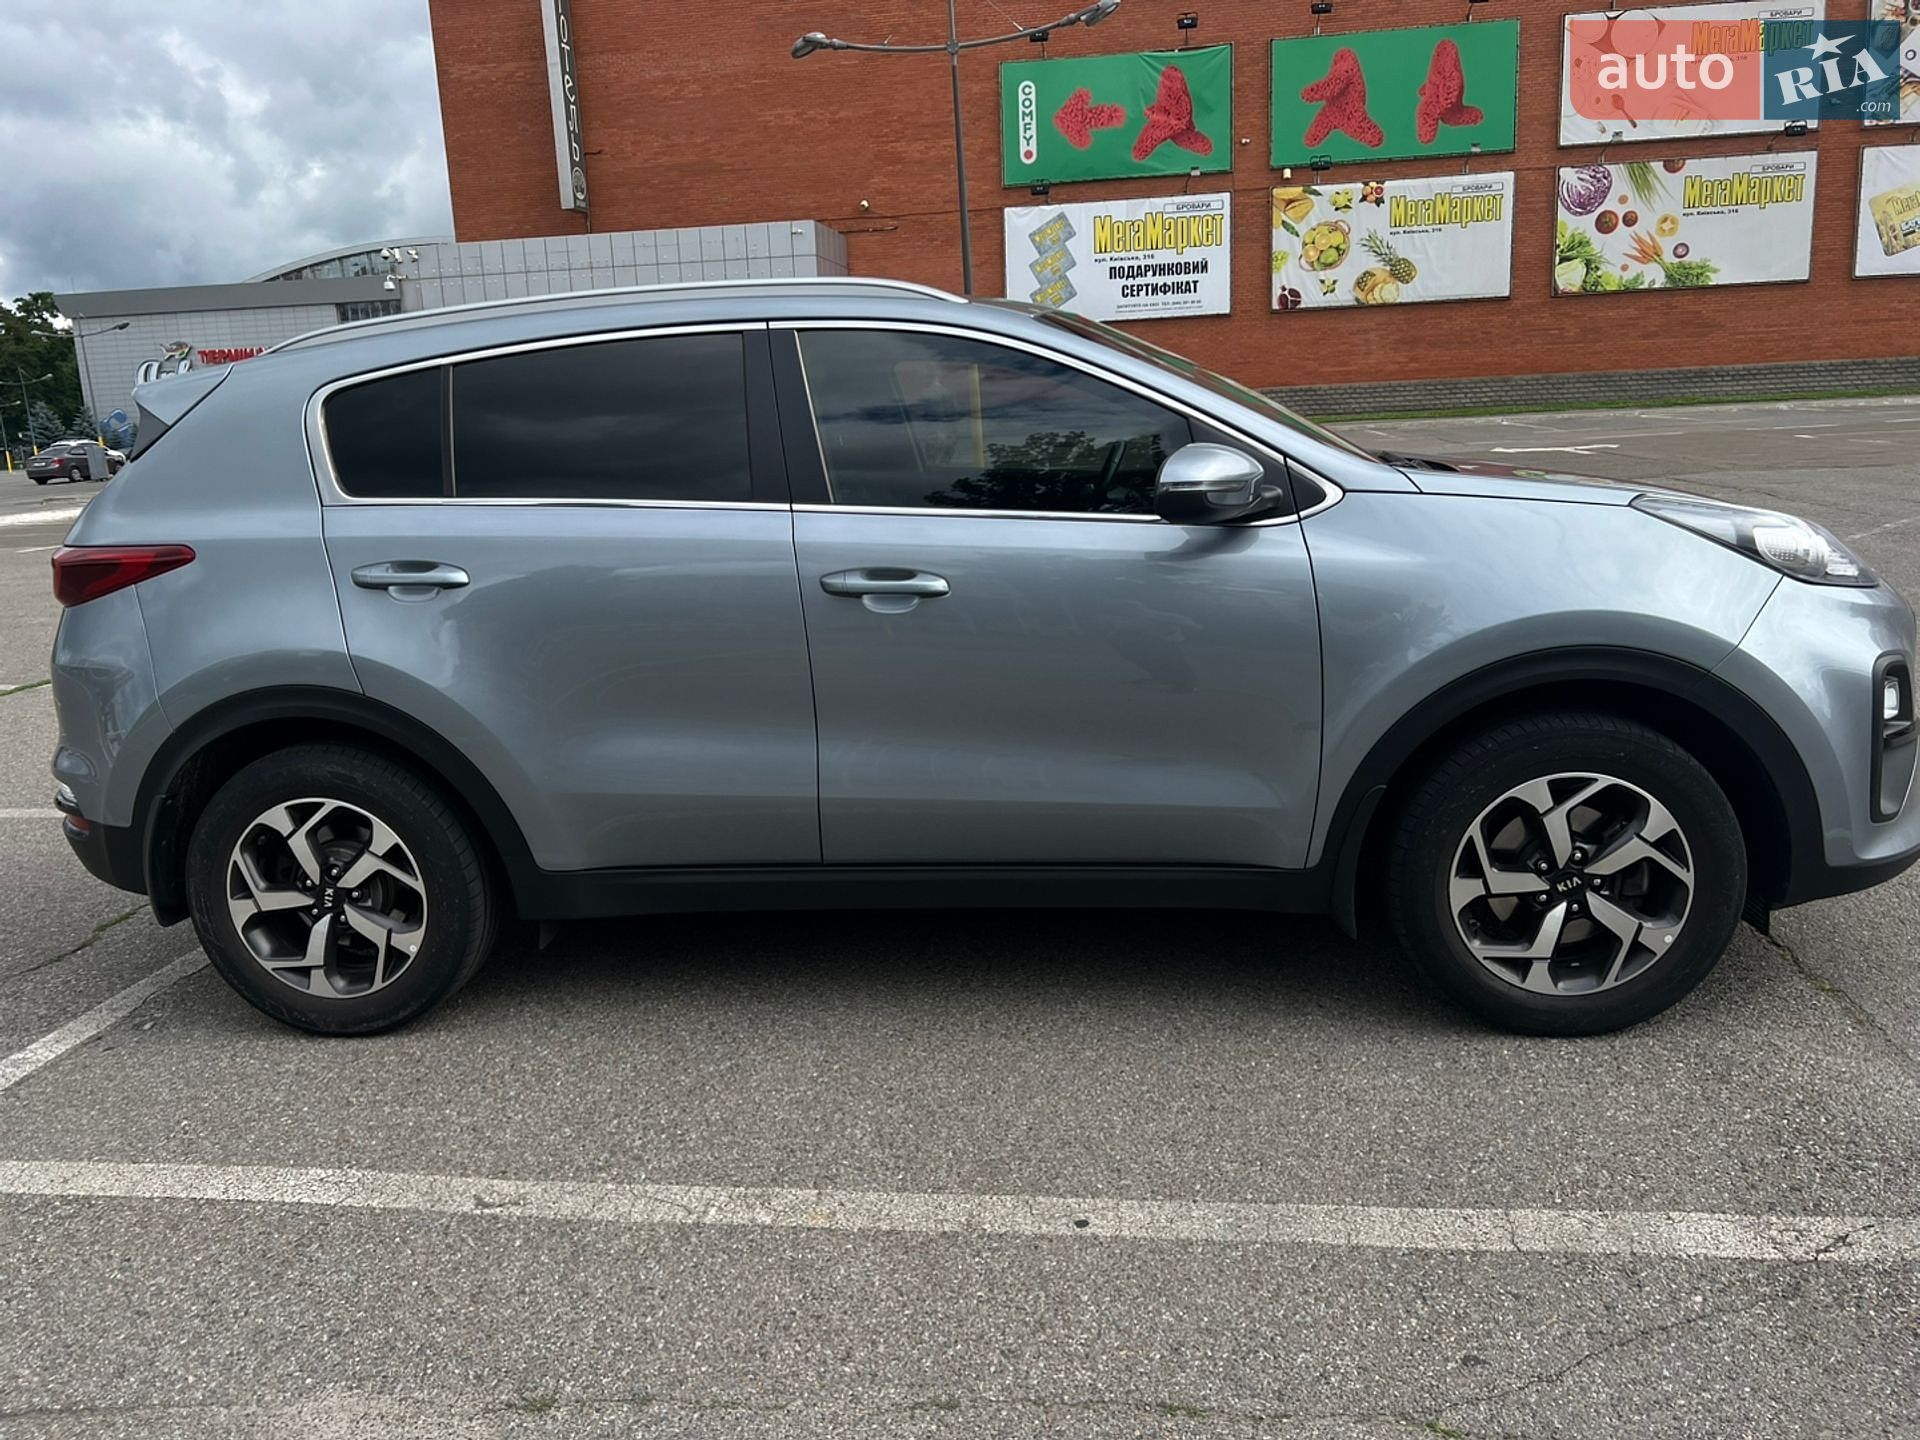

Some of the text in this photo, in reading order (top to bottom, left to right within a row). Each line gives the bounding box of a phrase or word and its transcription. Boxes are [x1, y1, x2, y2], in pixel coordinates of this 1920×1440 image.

[1691, 18, 1814, 56] МегаМаркет
[1022, 85, 1033, 147] COMFY
[1683, 172, 1806, 209] МегаМаркет
[1390, 192, 1504, 229] МегаМаркет
[1094, 211, 1224, 255] МегаМаркет
[1109, 258, 1208, 280] ПОДАРУНКОВИЙ
[1121, 280, 1199, 298] СЕРТИФІКАТ
[323, 888, 334, 907] KIA
[1556, 877, 1582, 892] KIA
